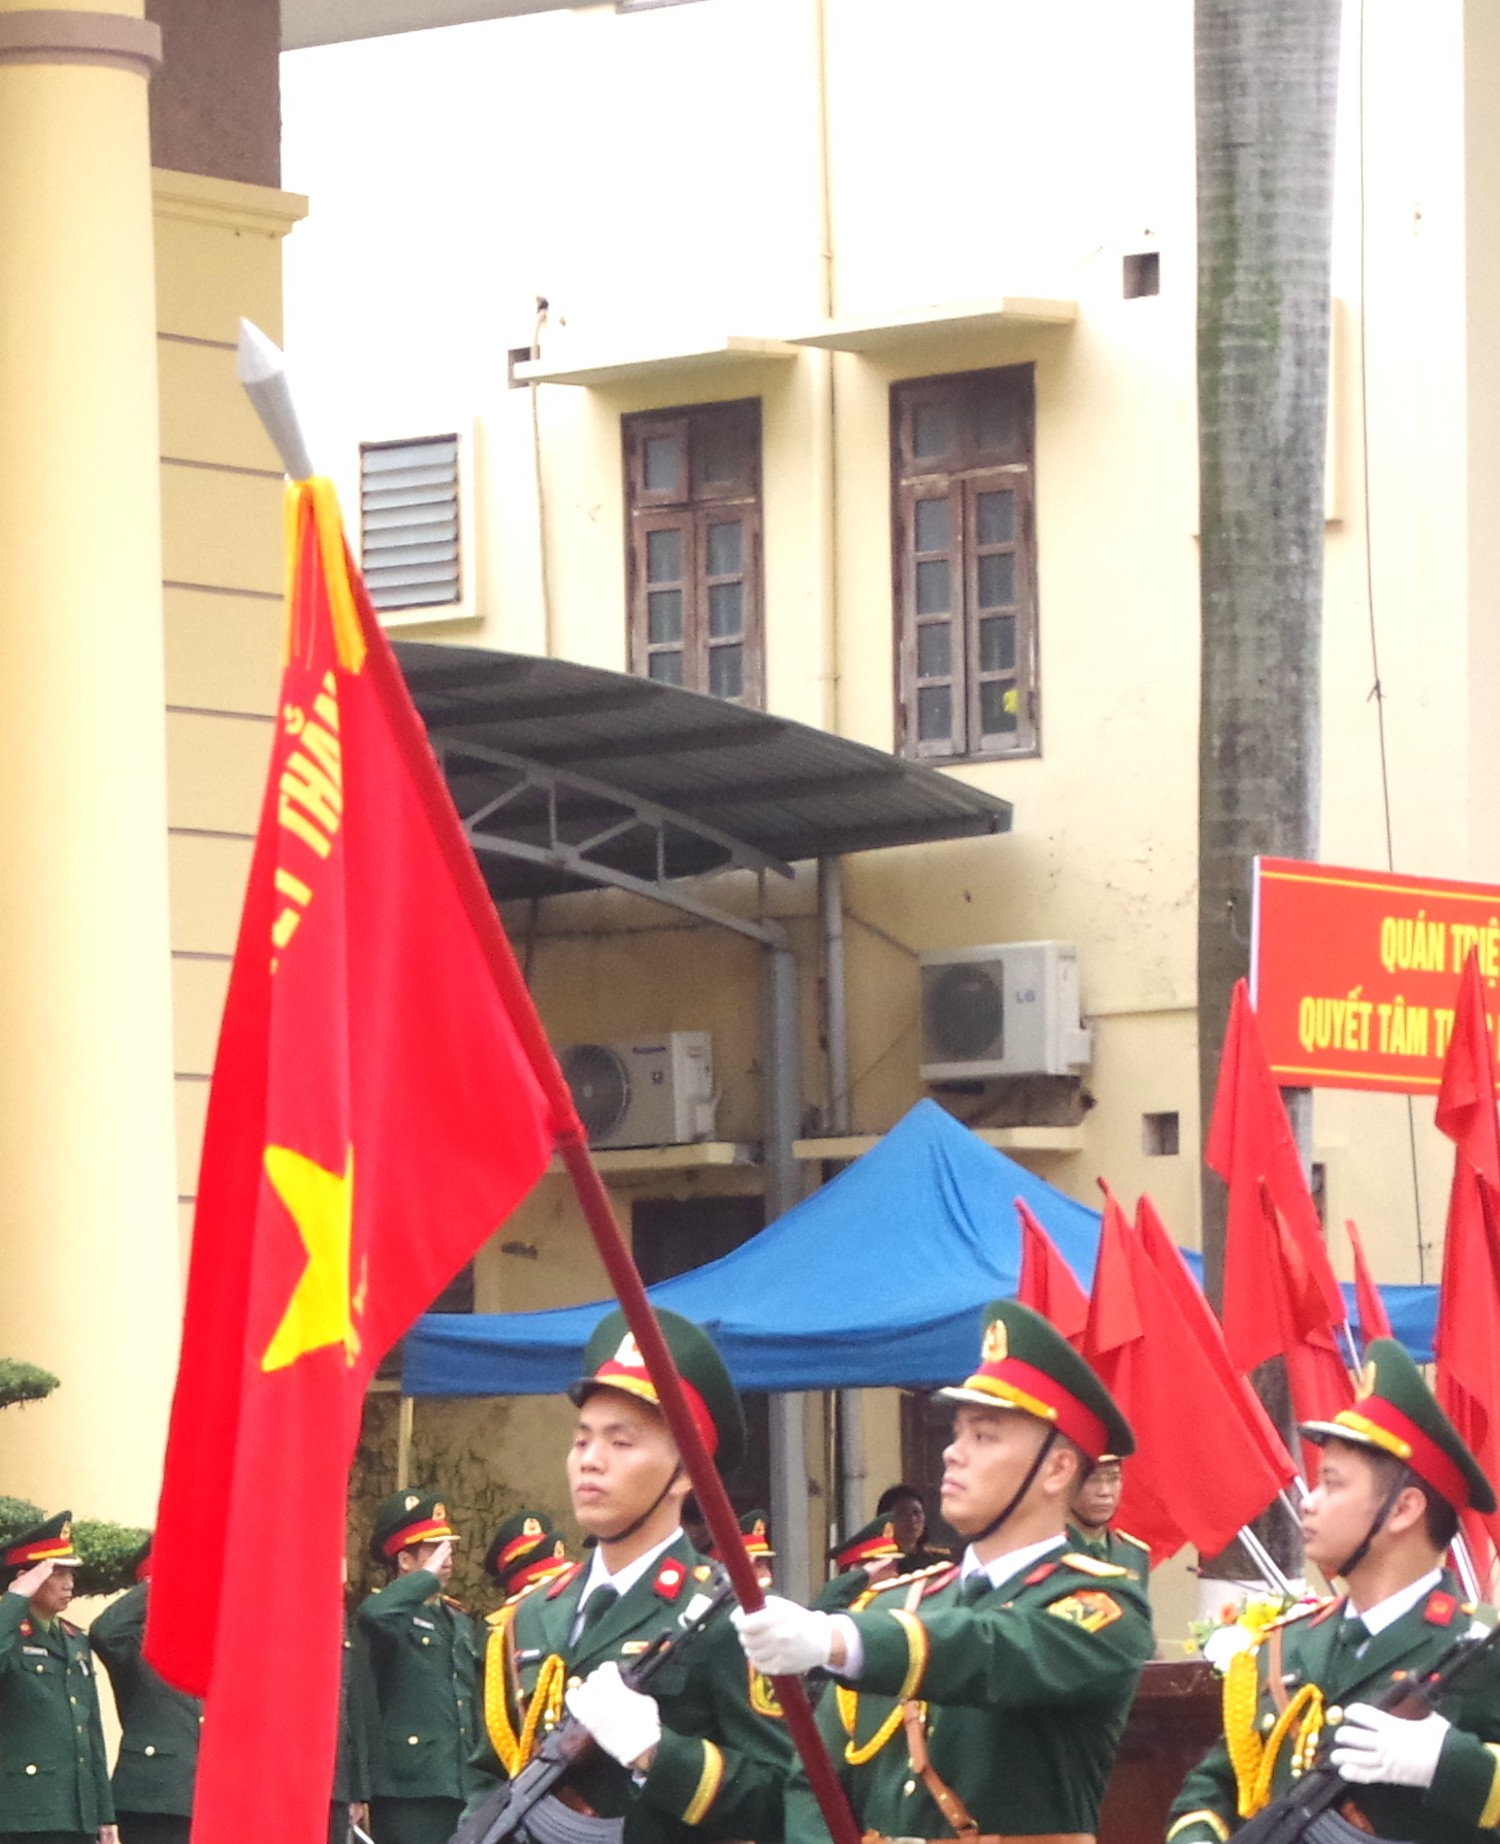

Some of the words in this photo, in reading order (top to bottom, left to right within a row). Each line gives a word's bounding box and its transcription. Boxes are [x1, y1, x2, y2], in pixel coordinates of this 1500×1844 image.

[277, 669, 344, 861] THẮ
[1381, 911, 1445, 972] QUÁN
[1300, 987, 1372, 1051] QUYẾT
[1378, 996, 1428, 1056] TÂM
